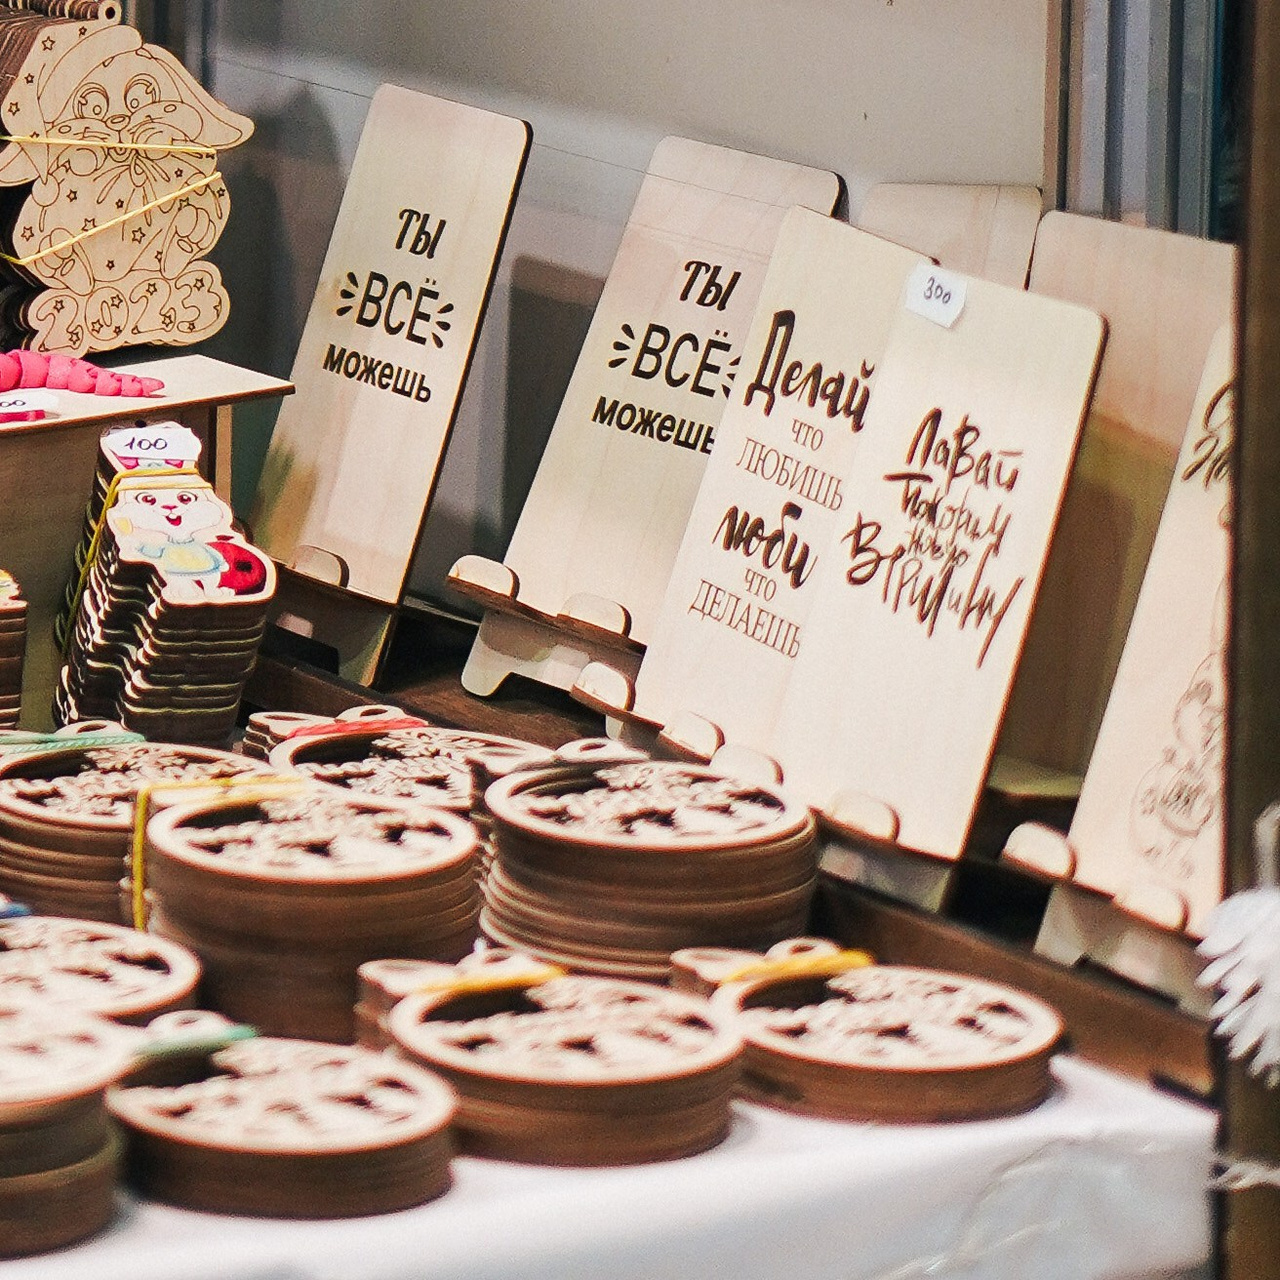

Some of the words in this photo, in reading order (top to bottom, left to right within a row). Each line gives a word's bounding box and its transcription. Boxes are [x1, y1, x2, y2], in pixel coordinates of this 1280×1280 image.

[36, 269, 222, 353] 2023
[356, 270, 440, 346] ВСЁ
[923, 276, 951, 305] 300
[322, 343, 432, 403] можешь
[631, 323, 732, 398] ВСЁ
[743, 309, 875, 433] Делай
[124, 436, 168, 451] 100
[736, 436, 843, 512] ЛЮБИШЬ
[687, 578, 801, 659] ДЕЛАЕШЬ
